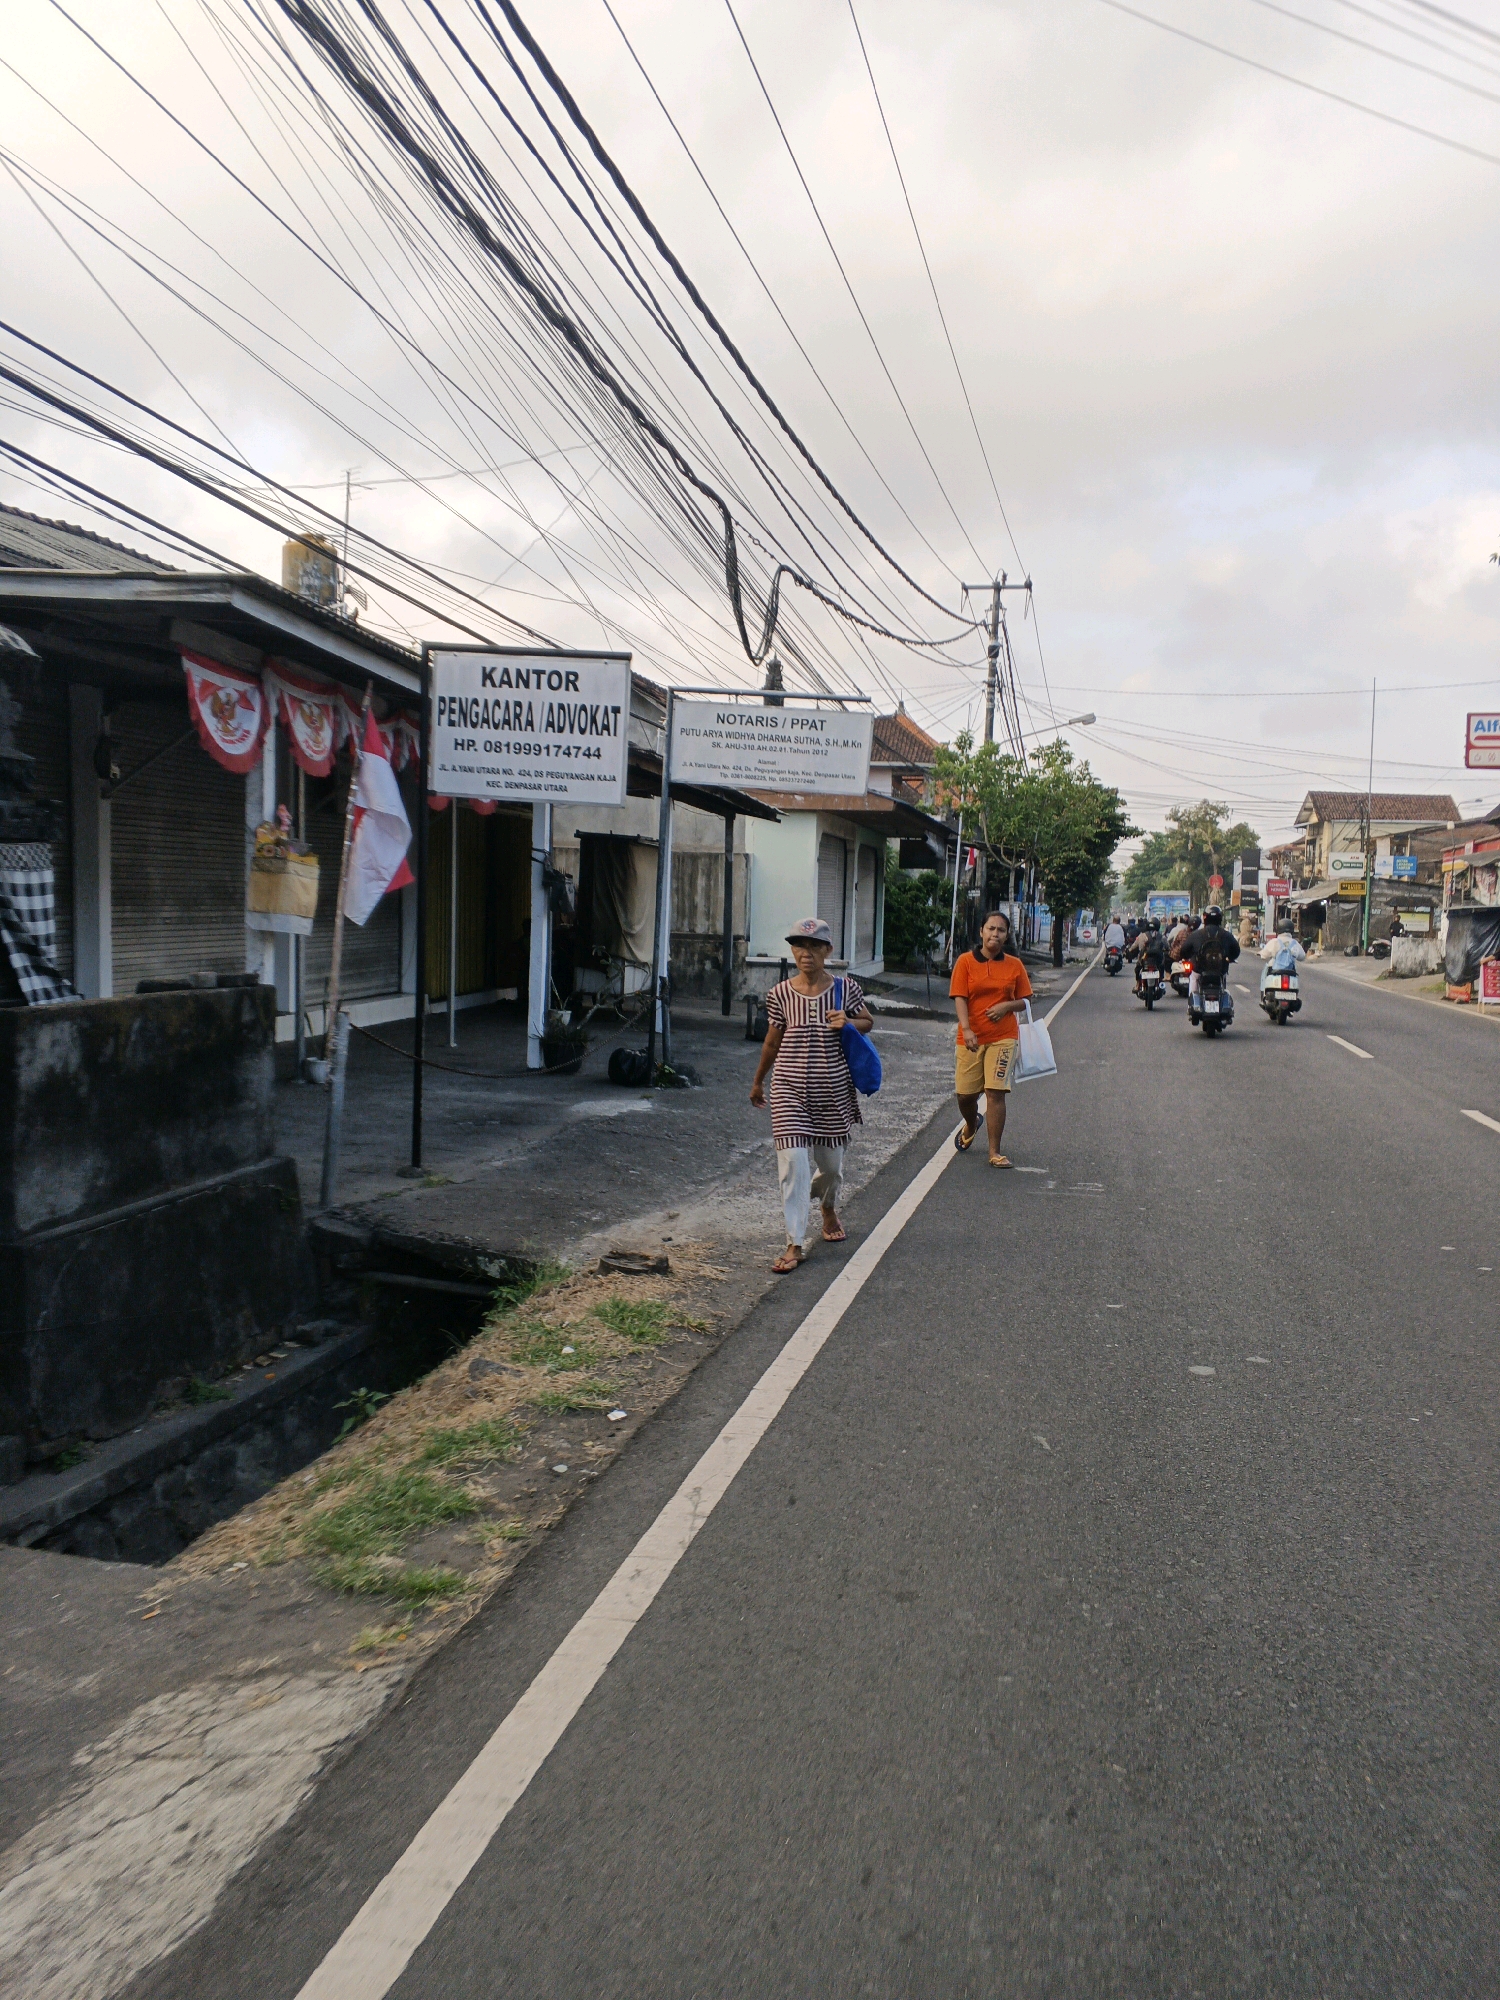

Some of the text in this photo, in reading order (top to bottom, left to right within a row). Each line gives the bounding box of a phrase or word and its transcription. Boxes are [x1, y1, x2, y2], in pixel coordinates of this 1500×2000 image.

[482, 666, 579, 692] KANTOR
[437, 696, 535, 732] PENGACARA
[716, 713, 778, 728] NOTARIS
[791, 718, 827, 731] PPAT
[1474, 719, 1500, 733] Alf
[680, 728, 701, 737] PUTU
[703, 729, 723, 738] ARYA
[725, 731, 755, 741] WIDHYA
[757, 733, 791, 743] DHARMA
[794, 735, 823, 747] SUTHA,
[711, 741, 723, 749] SK.
[454, 738, 602, 759] HP. 081999174744
[757, 758, 776, 766] Alamat
[476, 766, 500, 775] UTARA
[502, 768, 515, 776] NO.
[534, 769, 544, 778] DS
[546, 771, 595, 781] PEGUYANGAN
[596, 774, 617, 782] KAJA
[814, 771, 840, 779] Denpasar
[486, 780, 568, 792] KEC. DENPASAR UTARA
